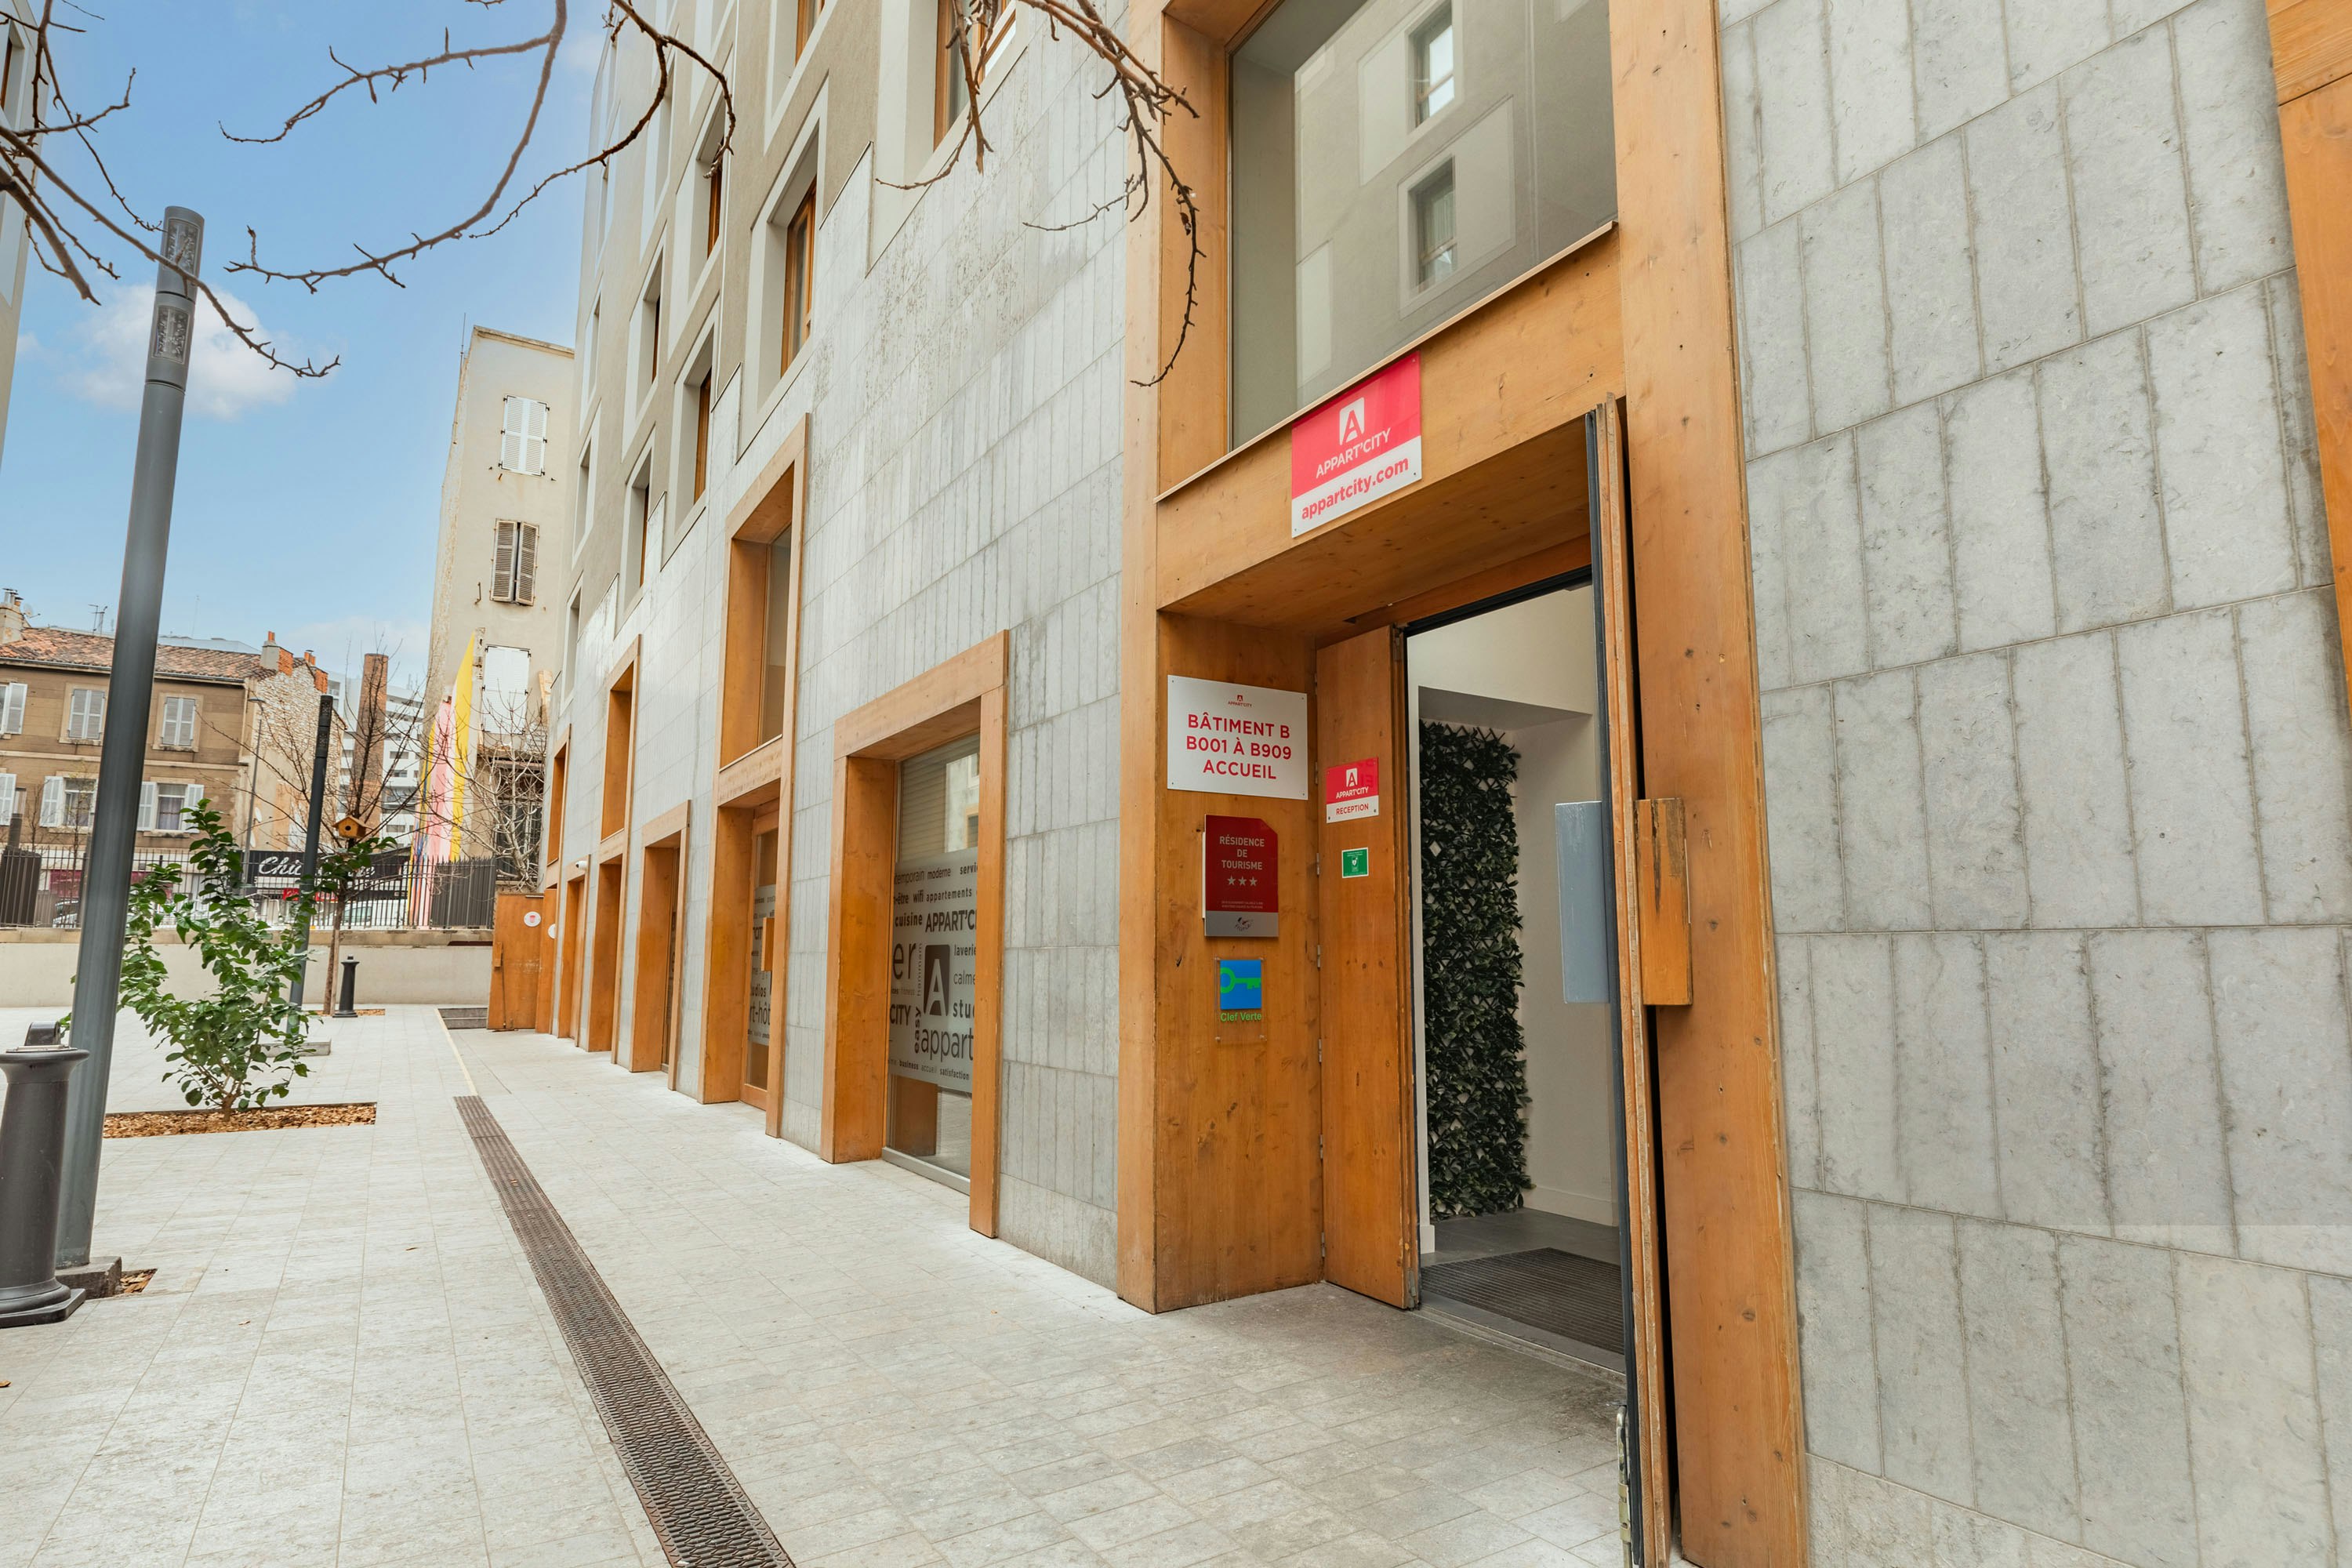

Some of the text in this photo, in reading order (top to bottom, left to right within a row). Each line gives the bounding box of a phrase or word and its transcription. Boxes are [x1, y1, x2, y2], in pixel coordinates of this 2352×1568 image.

[1339, 397, 1364, 445] A
[1316, 427, 1390, 478] APPART'CITY
[1301, 458, 1409, 520] appartcity.com
[1188, 712, 1290, 739] BÂTIMENT B
[1186, 735, 1291, 760] B001 À B909
[1203, 759, 1276, 779] ACCUEIL
[1346, 768, 1357, 787] A
[1336, 786, 1369, 799] APPART'CITY
[1336, 803, 1369, 815] RECEPTION
[1219, 834, 1265, 847] RÉSIDENCE
[1236, 849, 1247, 858] DE
[960, 862, 978, 875] servi
[1221, 859, 1263, 870] TOURISME
[913, 890, 924, 903] wifi
[926, 887, 972, 903] appartements
[895, 912, 923, 927] cuisine
[893, 943, 916, 979] er
[924, 947, 949, 1016] A
[1220, 1011, 1261, 1022] Clef Verte
[940, 1068, 970, 1080] satisfaction
